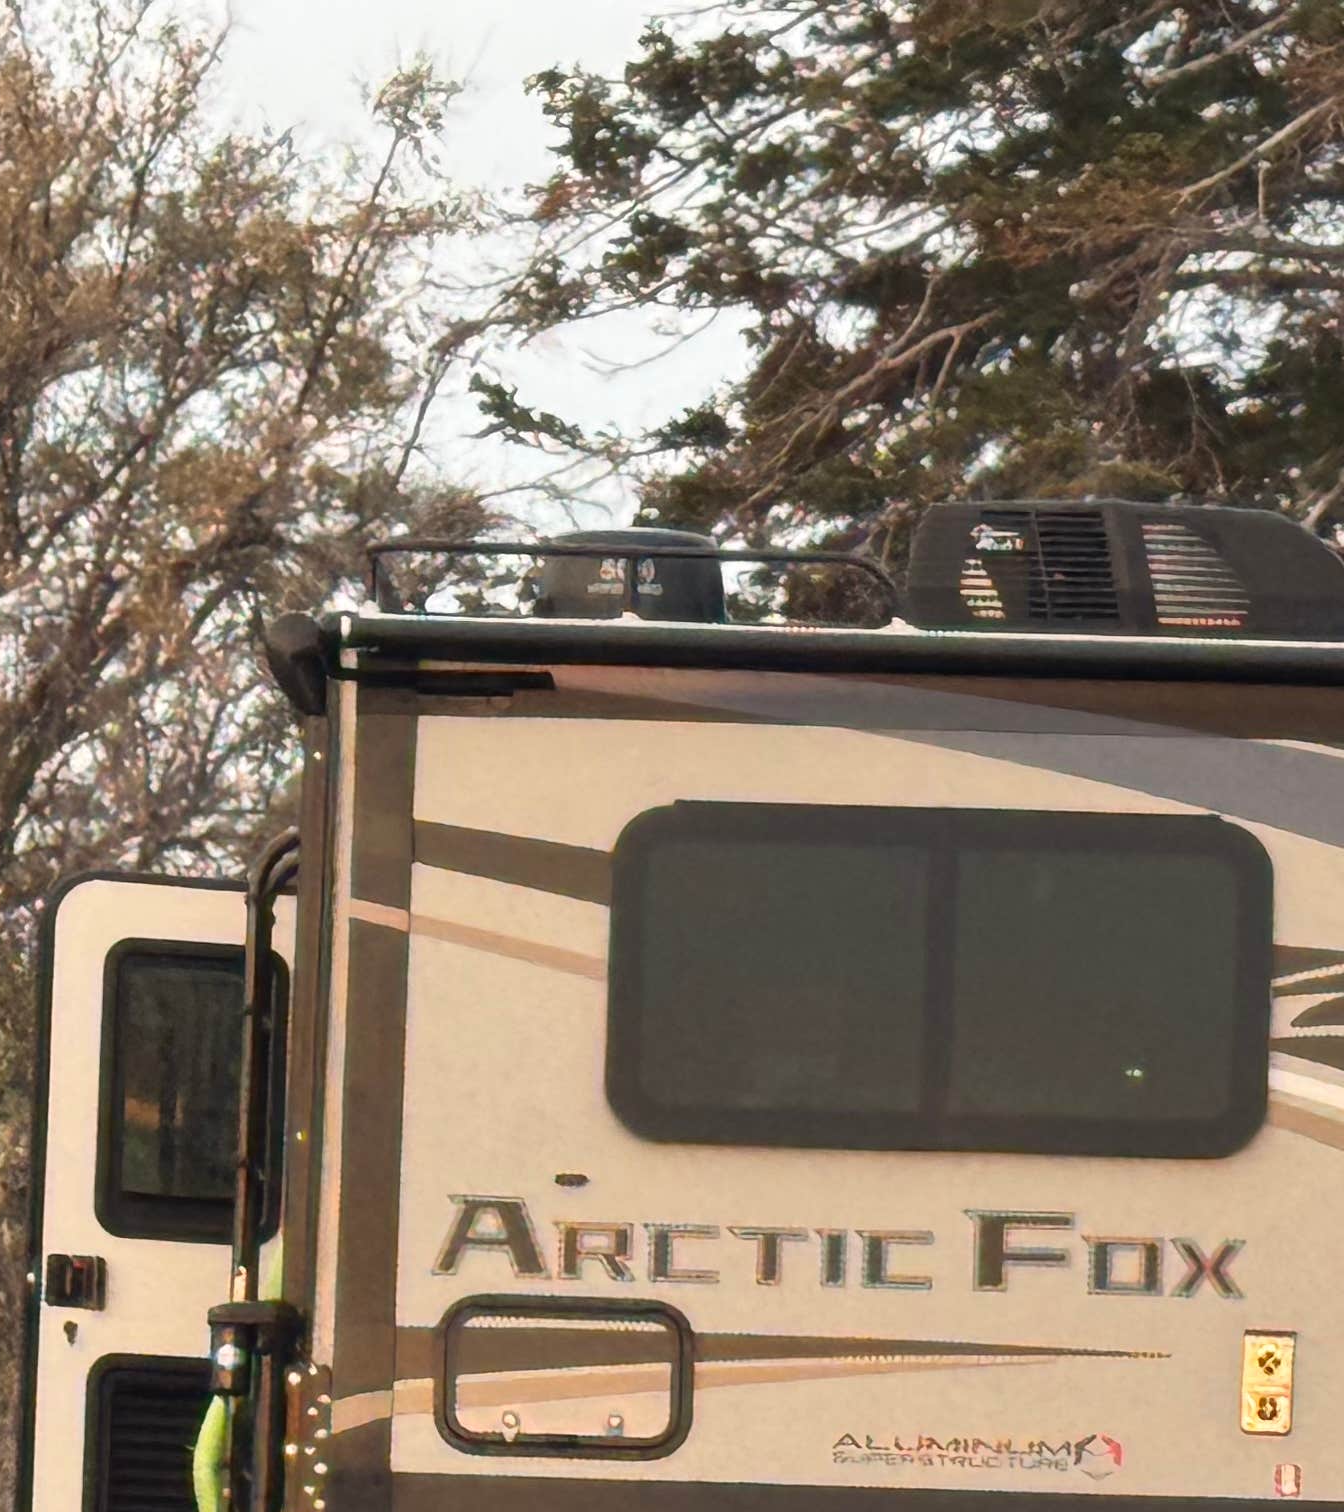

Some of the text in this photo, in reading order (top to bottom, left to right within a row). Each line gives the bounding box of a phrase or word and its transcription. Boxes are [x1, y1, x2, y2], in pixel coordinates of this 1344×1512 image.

[430, 1193, 1249, 1300] ARCTIC FOX
[832, 1433, 1072, 1457] ALUMINUM
